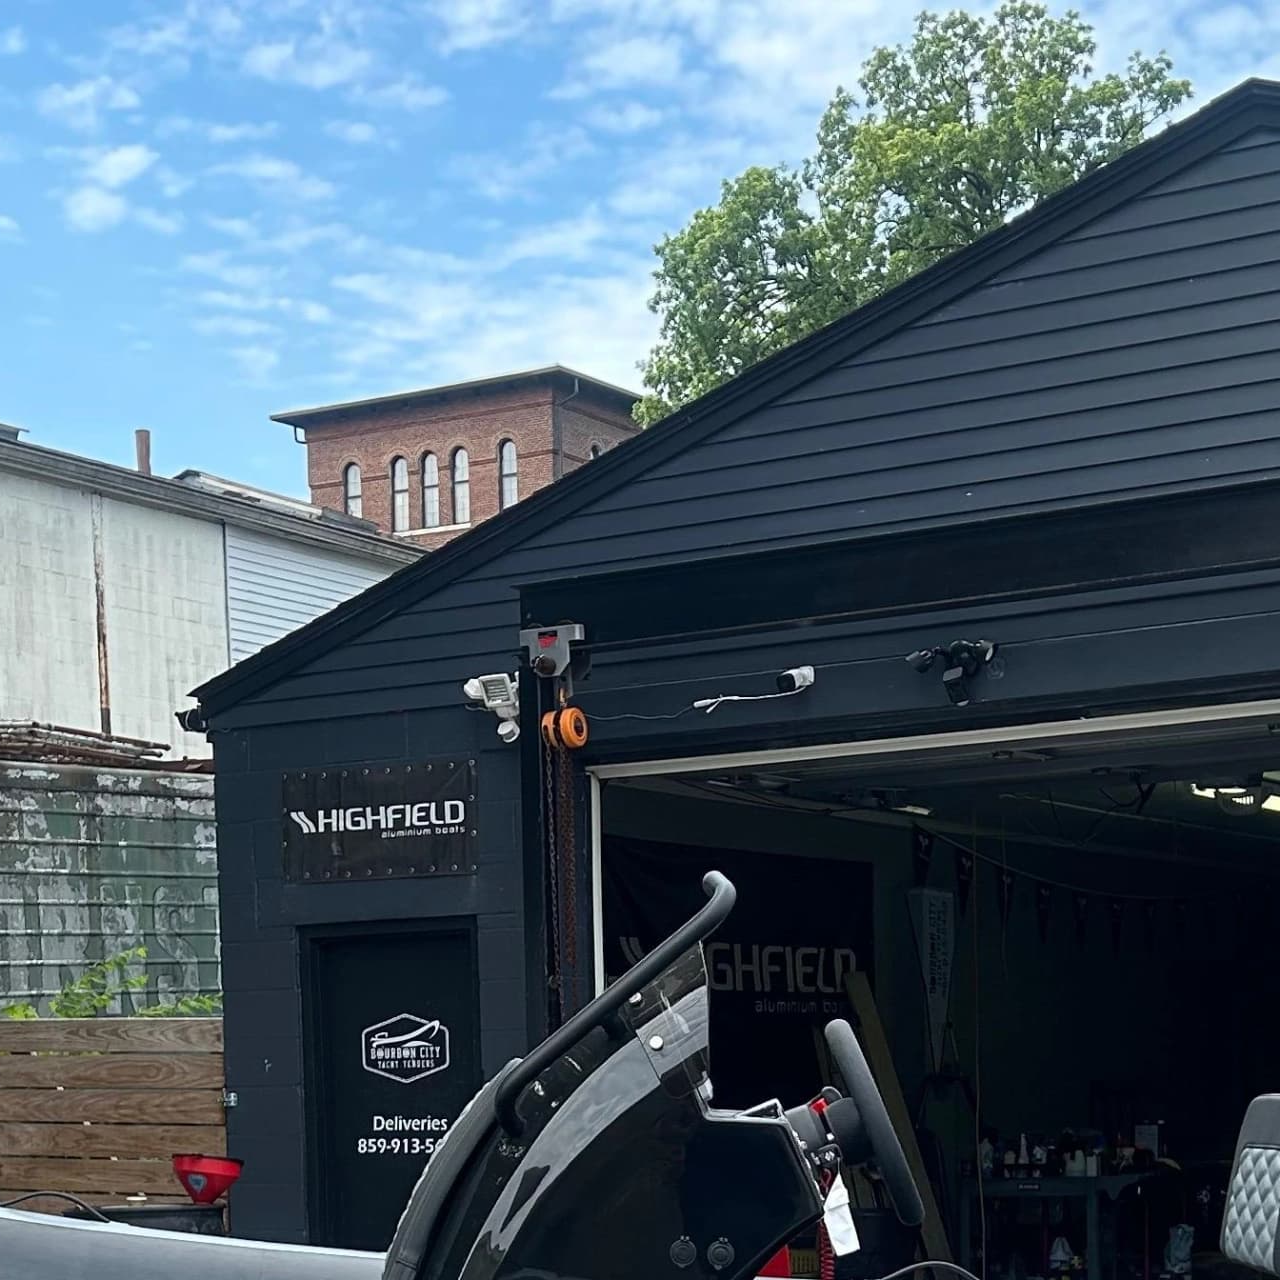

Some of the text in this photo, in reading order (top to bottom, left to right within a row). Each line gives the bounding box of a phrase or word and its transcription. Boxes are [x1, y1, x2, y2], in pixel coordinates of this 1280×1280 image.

[318, 800, 466, 833] HIGHFIELD
[381, 824, 466, 839] aluminium boats
[370, 1046, 441, 1060] BOURBON CITY
[377, 1059, 435, 1069] YACHT TENDERS
[373, 1115, 448, 1132] Deliveries
[357, 1138, 437, 1154] 859-913-5
